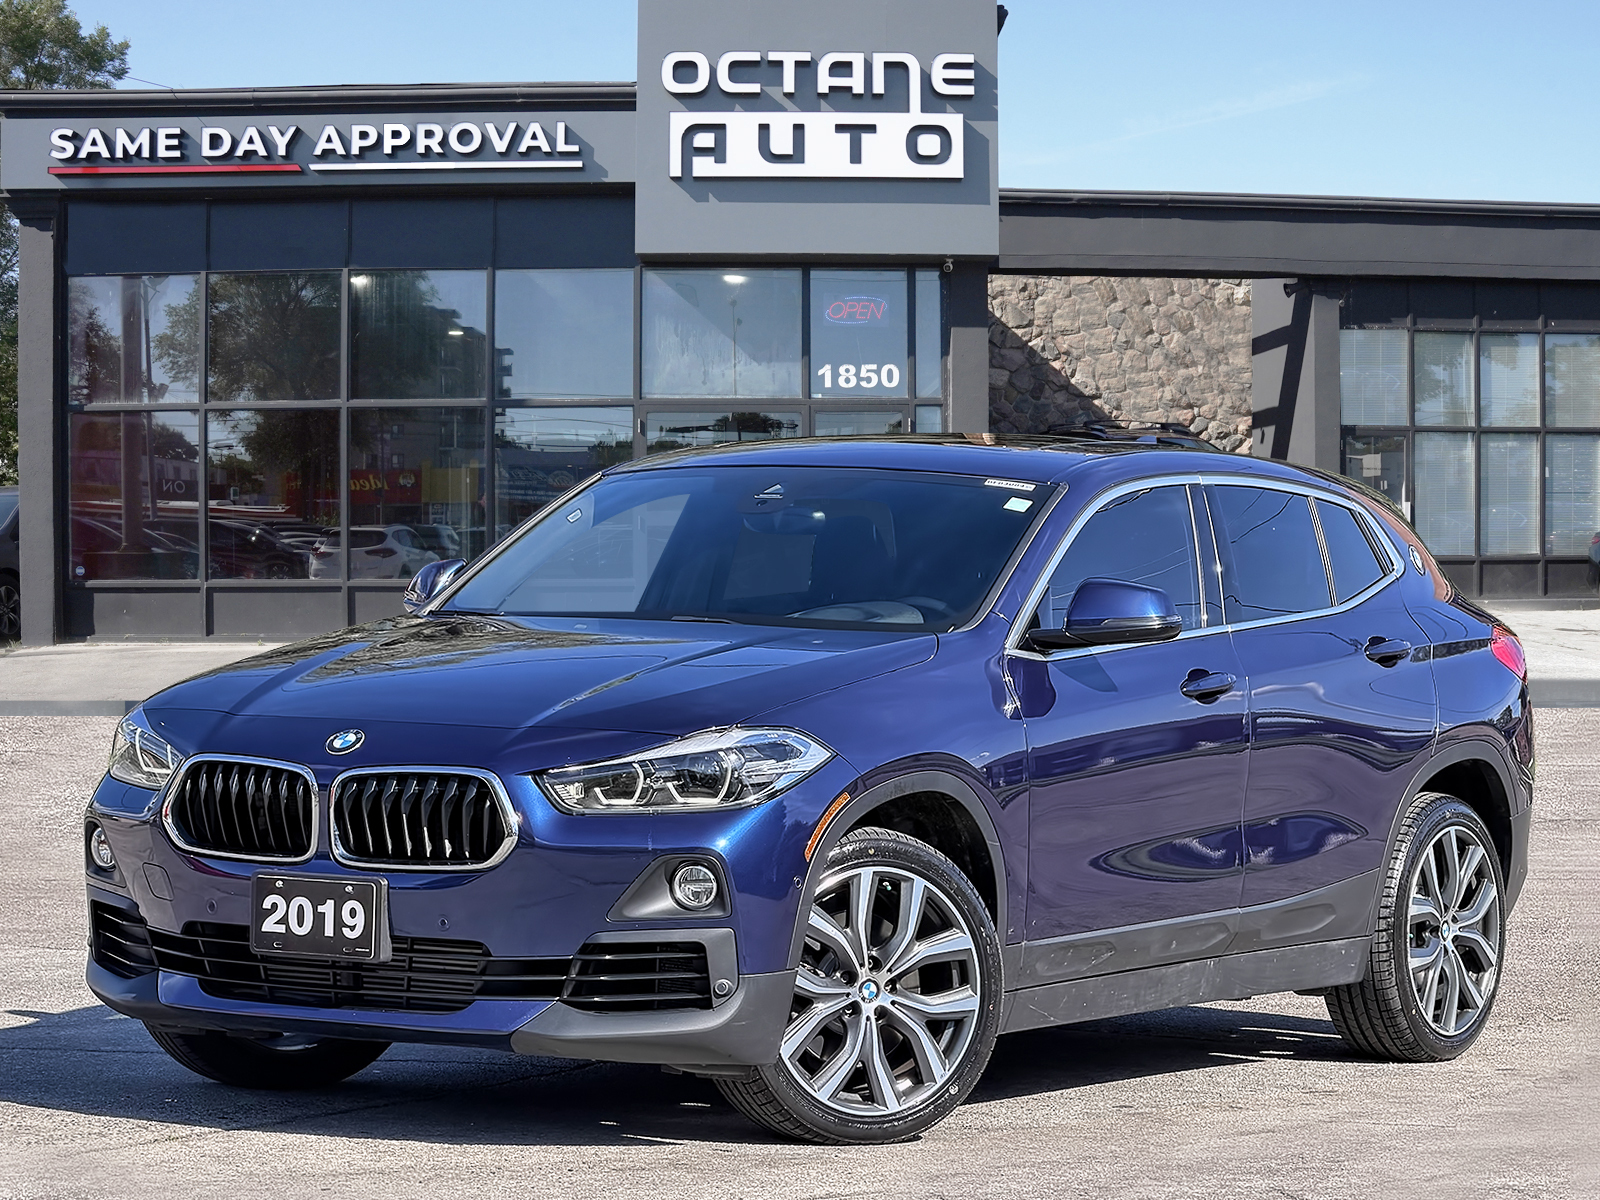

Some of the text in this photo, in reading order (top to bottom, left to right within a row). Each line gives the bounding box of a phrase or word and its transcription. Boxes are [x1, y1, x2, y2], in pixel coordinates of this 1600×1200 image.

[661, 51, 975, 96] OCTANE
[49, 121, 580, 159] SAME DAY APPROVAL
[680, 121, 954, 176] AUTO
[829, 302, 885, 319] OPEN
[817, 363, 900, 389] 1850
[261, 894, 366, 940] 2019
